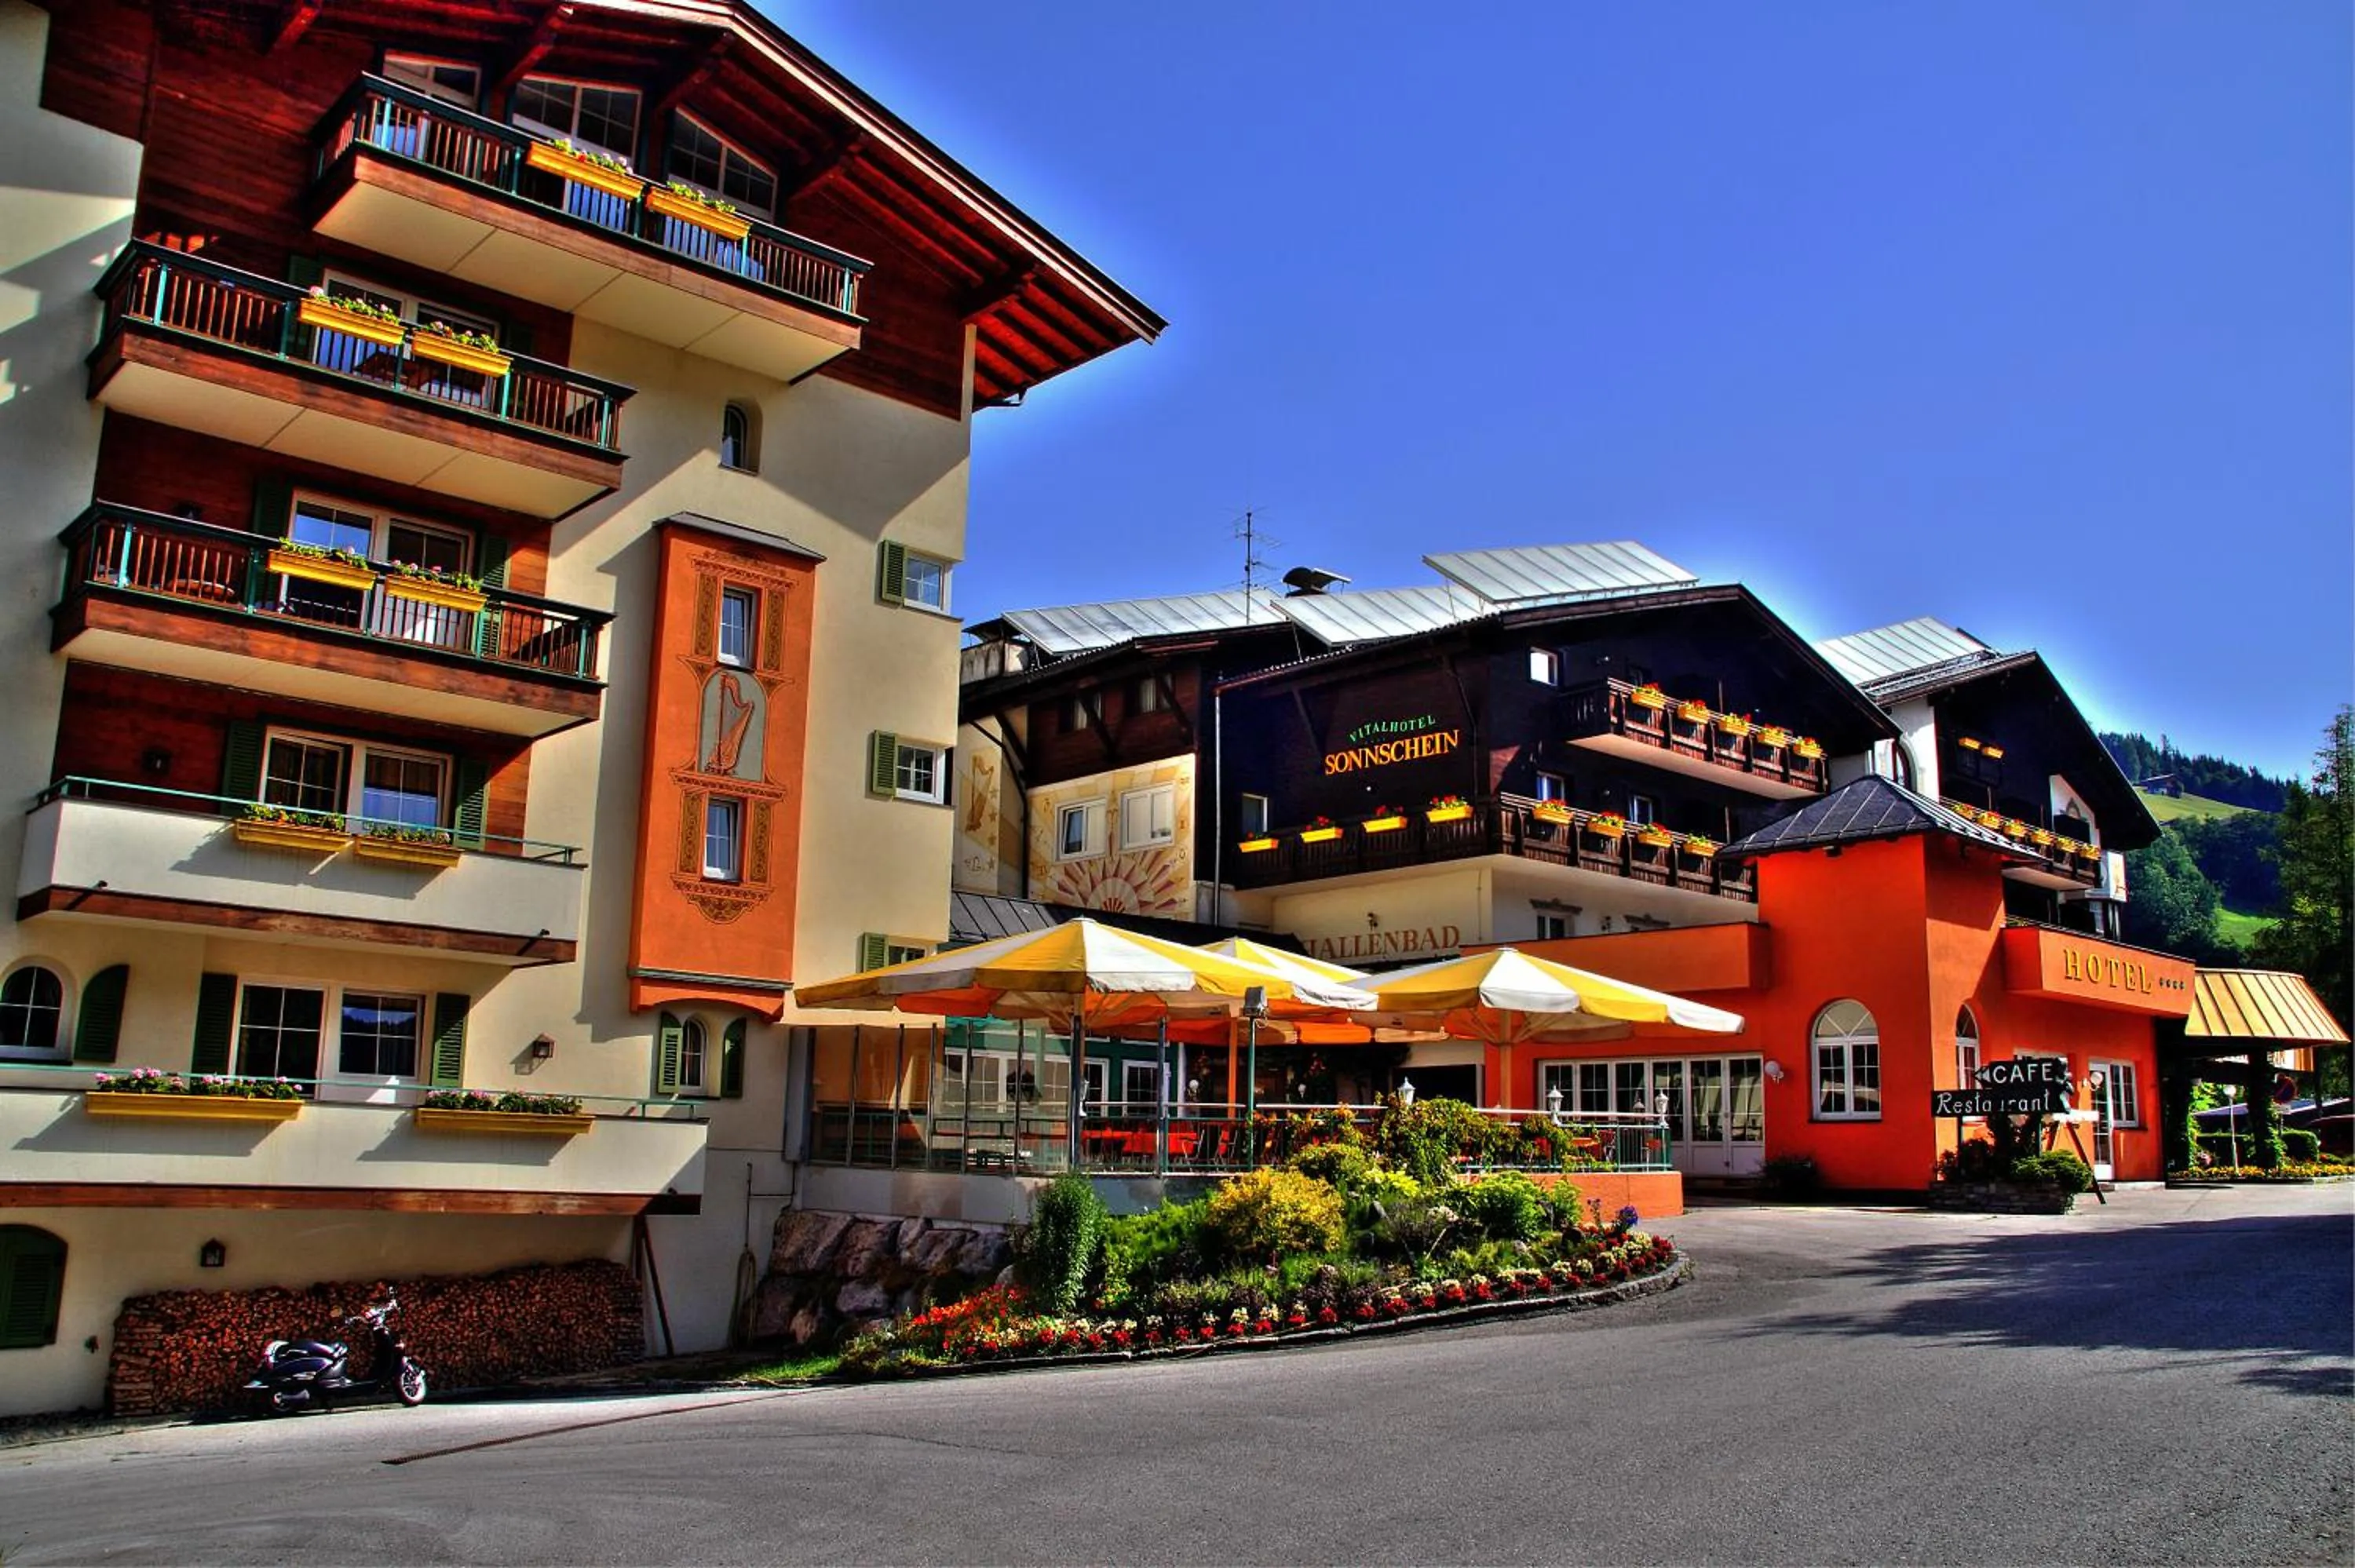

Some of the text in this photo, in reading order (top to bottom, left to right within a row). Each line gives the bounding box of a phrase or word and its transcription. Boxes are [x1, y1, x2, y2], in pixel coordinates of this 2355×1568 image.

[1349, 715, 1436, 742] VITALHOTEL
[1324, 730, 1459, 775] SONNSCHEIN
[2063, 949, 2152, 994] HOTEL
[1992, 1063, 2054, 1084] CAFE
